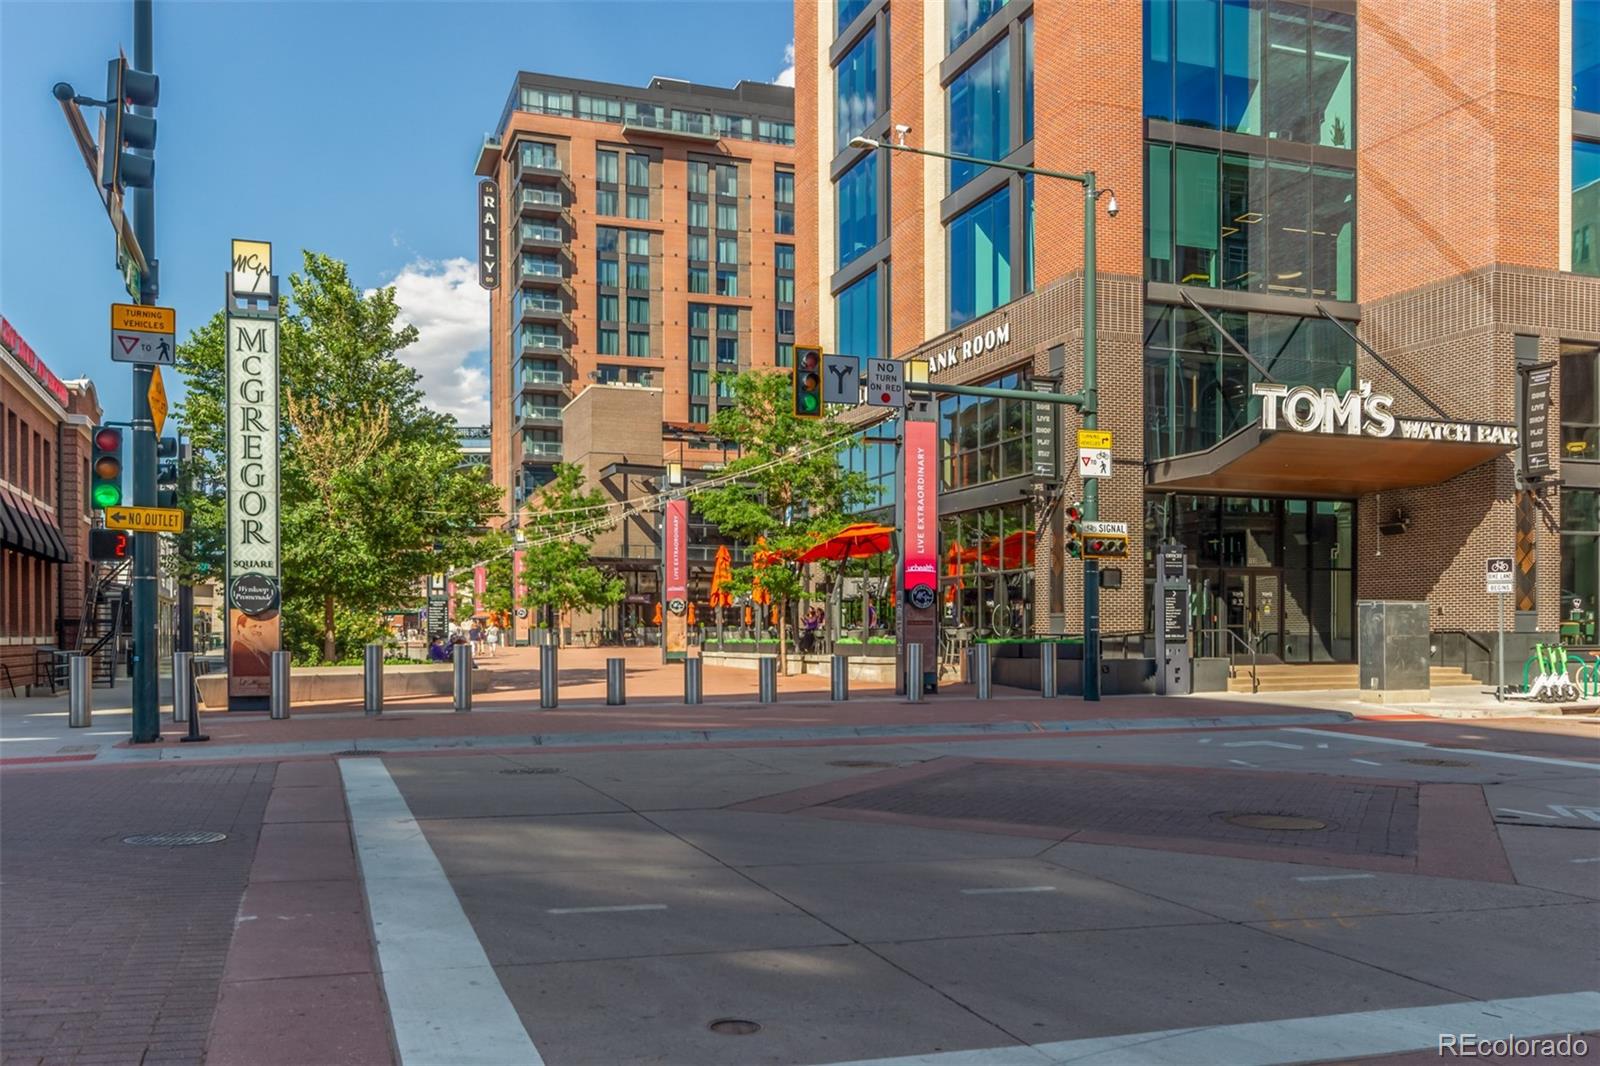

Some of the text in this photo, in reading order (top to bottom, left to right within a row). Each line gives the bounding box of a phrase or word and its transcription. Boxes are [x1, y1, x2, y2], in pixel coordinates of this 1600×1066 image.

[483, 195, 496, 273] RALLY
[126, 309, 163, 319] TURNING
[123, 319, 165, 329] VEHICLES
[141, 344, 152, 352] TO
[928, 322, 1010, 373] ANK ROOM
[877, 363, 895, 373] NO
[875, 374, 897, 382] TURN
[885, 384, 902, 392] RED
[1252, 380, 1519, 445] TOM'S WATCH BAR
[235, 327, 271, 544] MCGREGOR
[917, 447, 925, 554] LIVE EXTRAORDINARY
[128, 512, 179, 527] NO OUTLET
[1098, 524, 1125, 533] SIGNAL
[115, 534, 127, 556] 2
[233, 560, 274, 569] SQUARE
